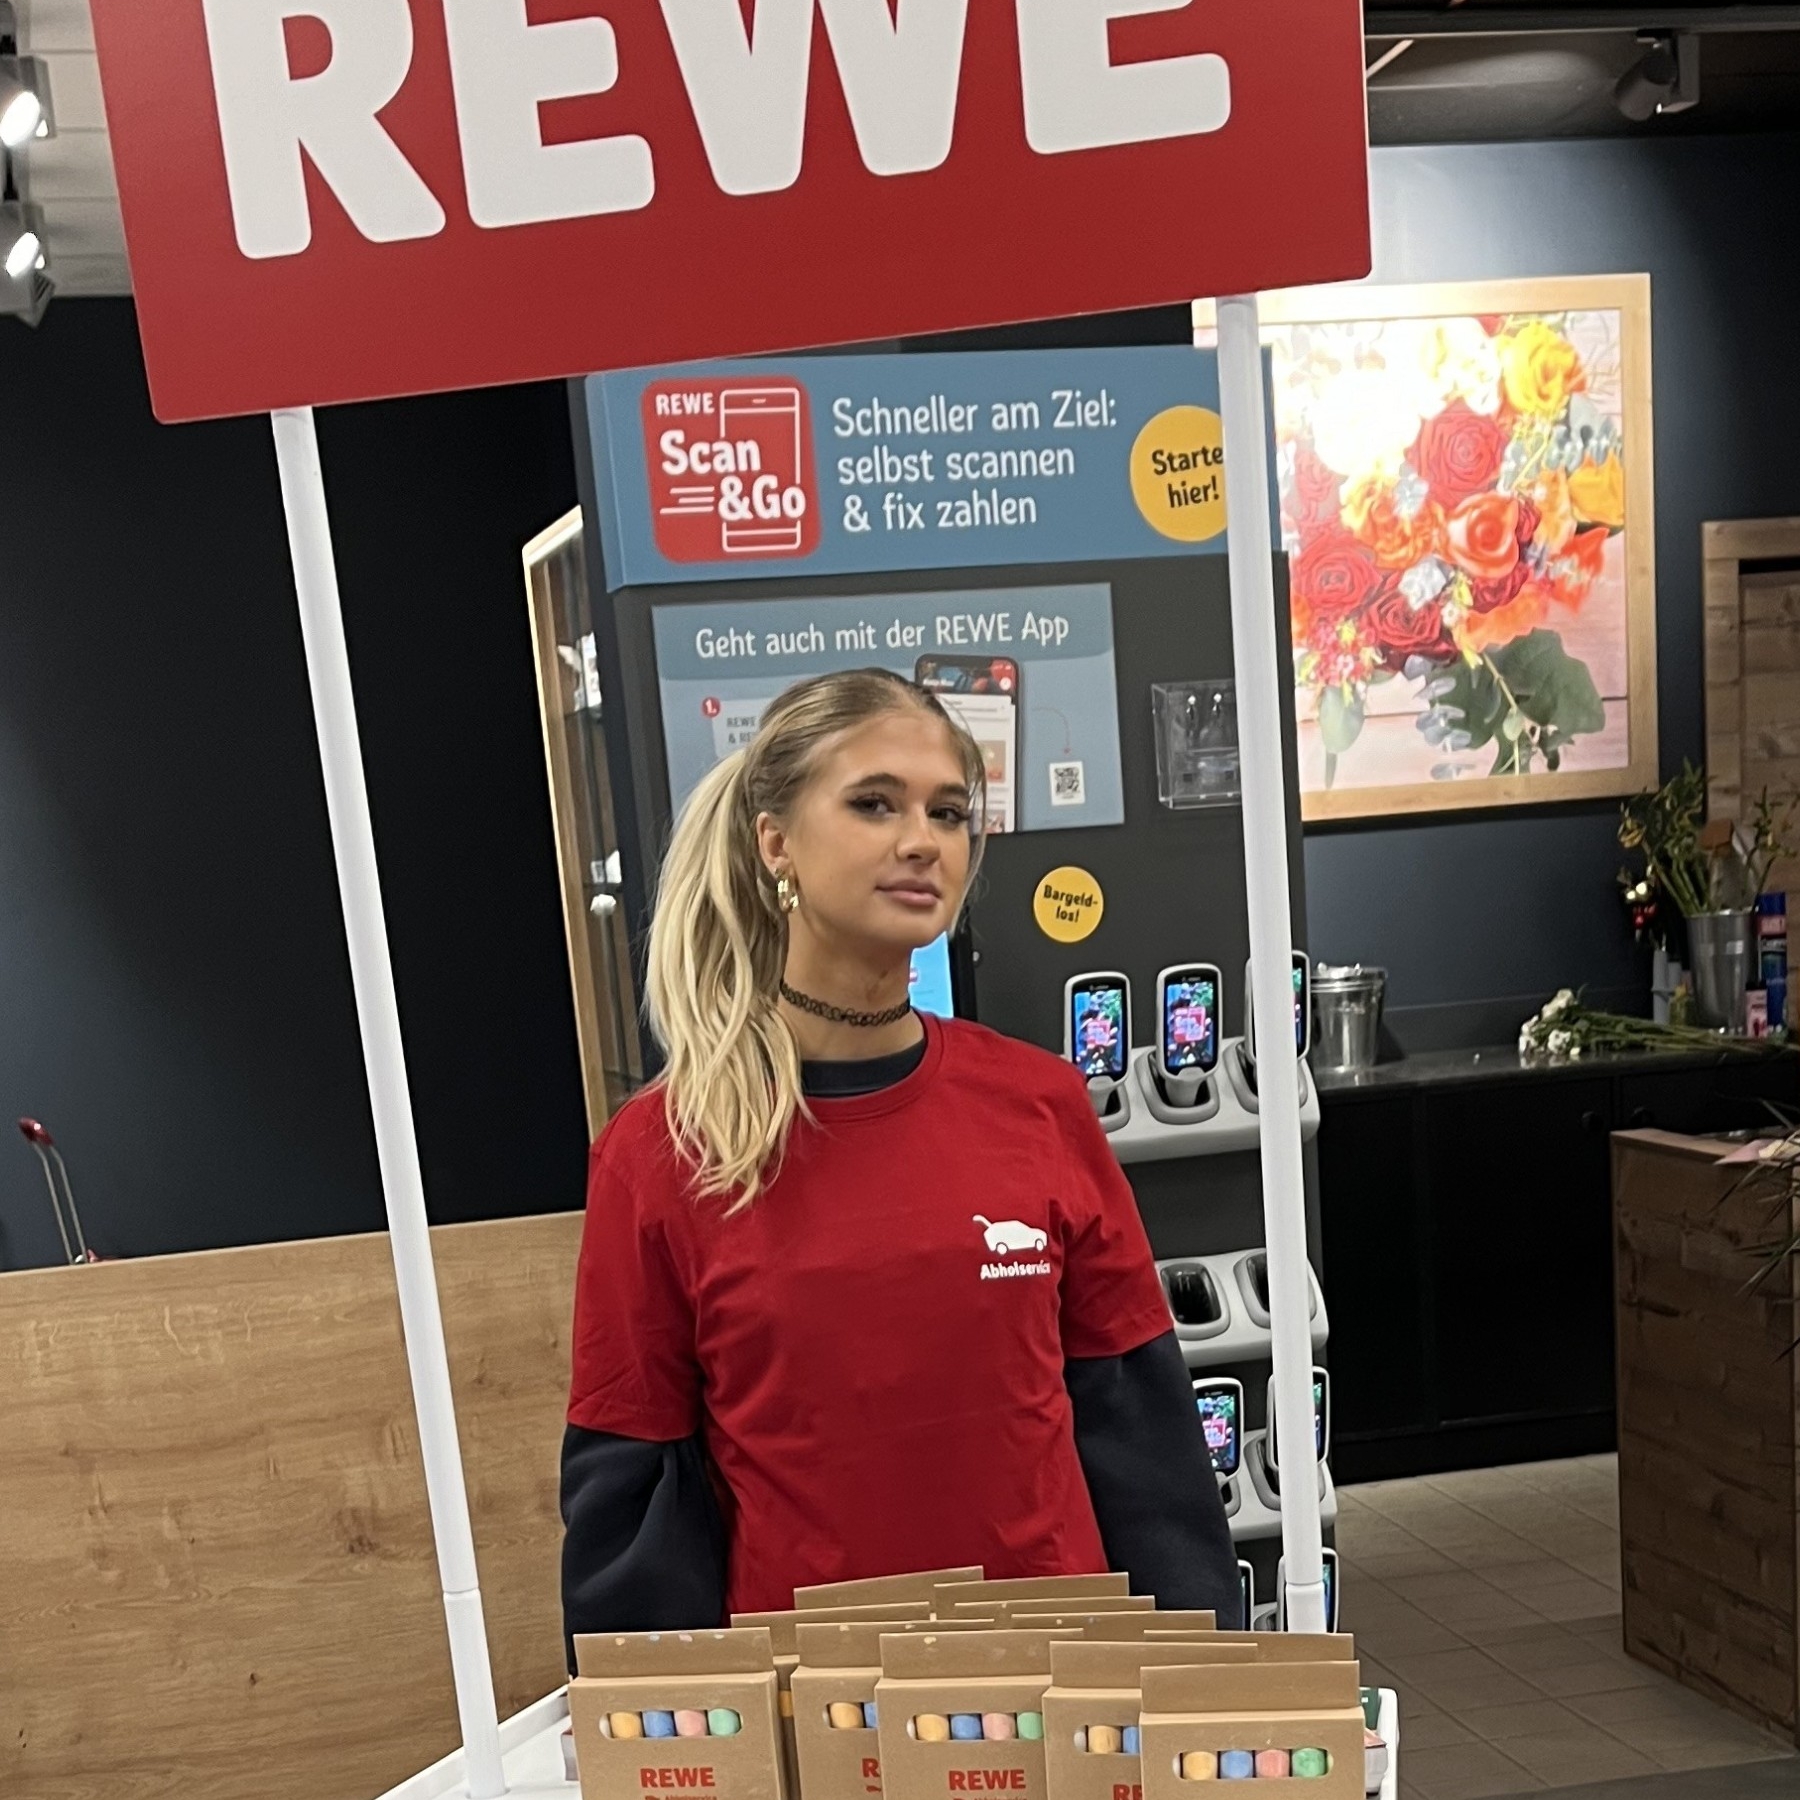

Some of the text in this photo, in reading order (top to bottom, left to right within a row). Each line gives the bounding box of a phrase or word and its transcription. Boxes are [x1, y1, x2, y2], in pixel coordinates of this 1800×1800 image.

[656, 392, 715, 416] REWE
[832, 389, 1117, 437] Schneller am Ziel:
[660, 429, 761, 475] Scan
[837, 445, 1075, 485] selbst scannen
[1151, 445, 1224, 476] Starte
[718, 474, 806, 521] &Go
[1167, 475, 1220, 508] hier!
[842, 487, 1037, 532] & fix zahlen
[695, 611, 1069, 659] Geht auch mit der REWE App
[1043, 884, 1099, 908] Bargeld-
[1056, 904, 1080, 923] los!
[640, 1766, 716, 1788] REWE
[948, 1768, 1027, 1791] REWE
